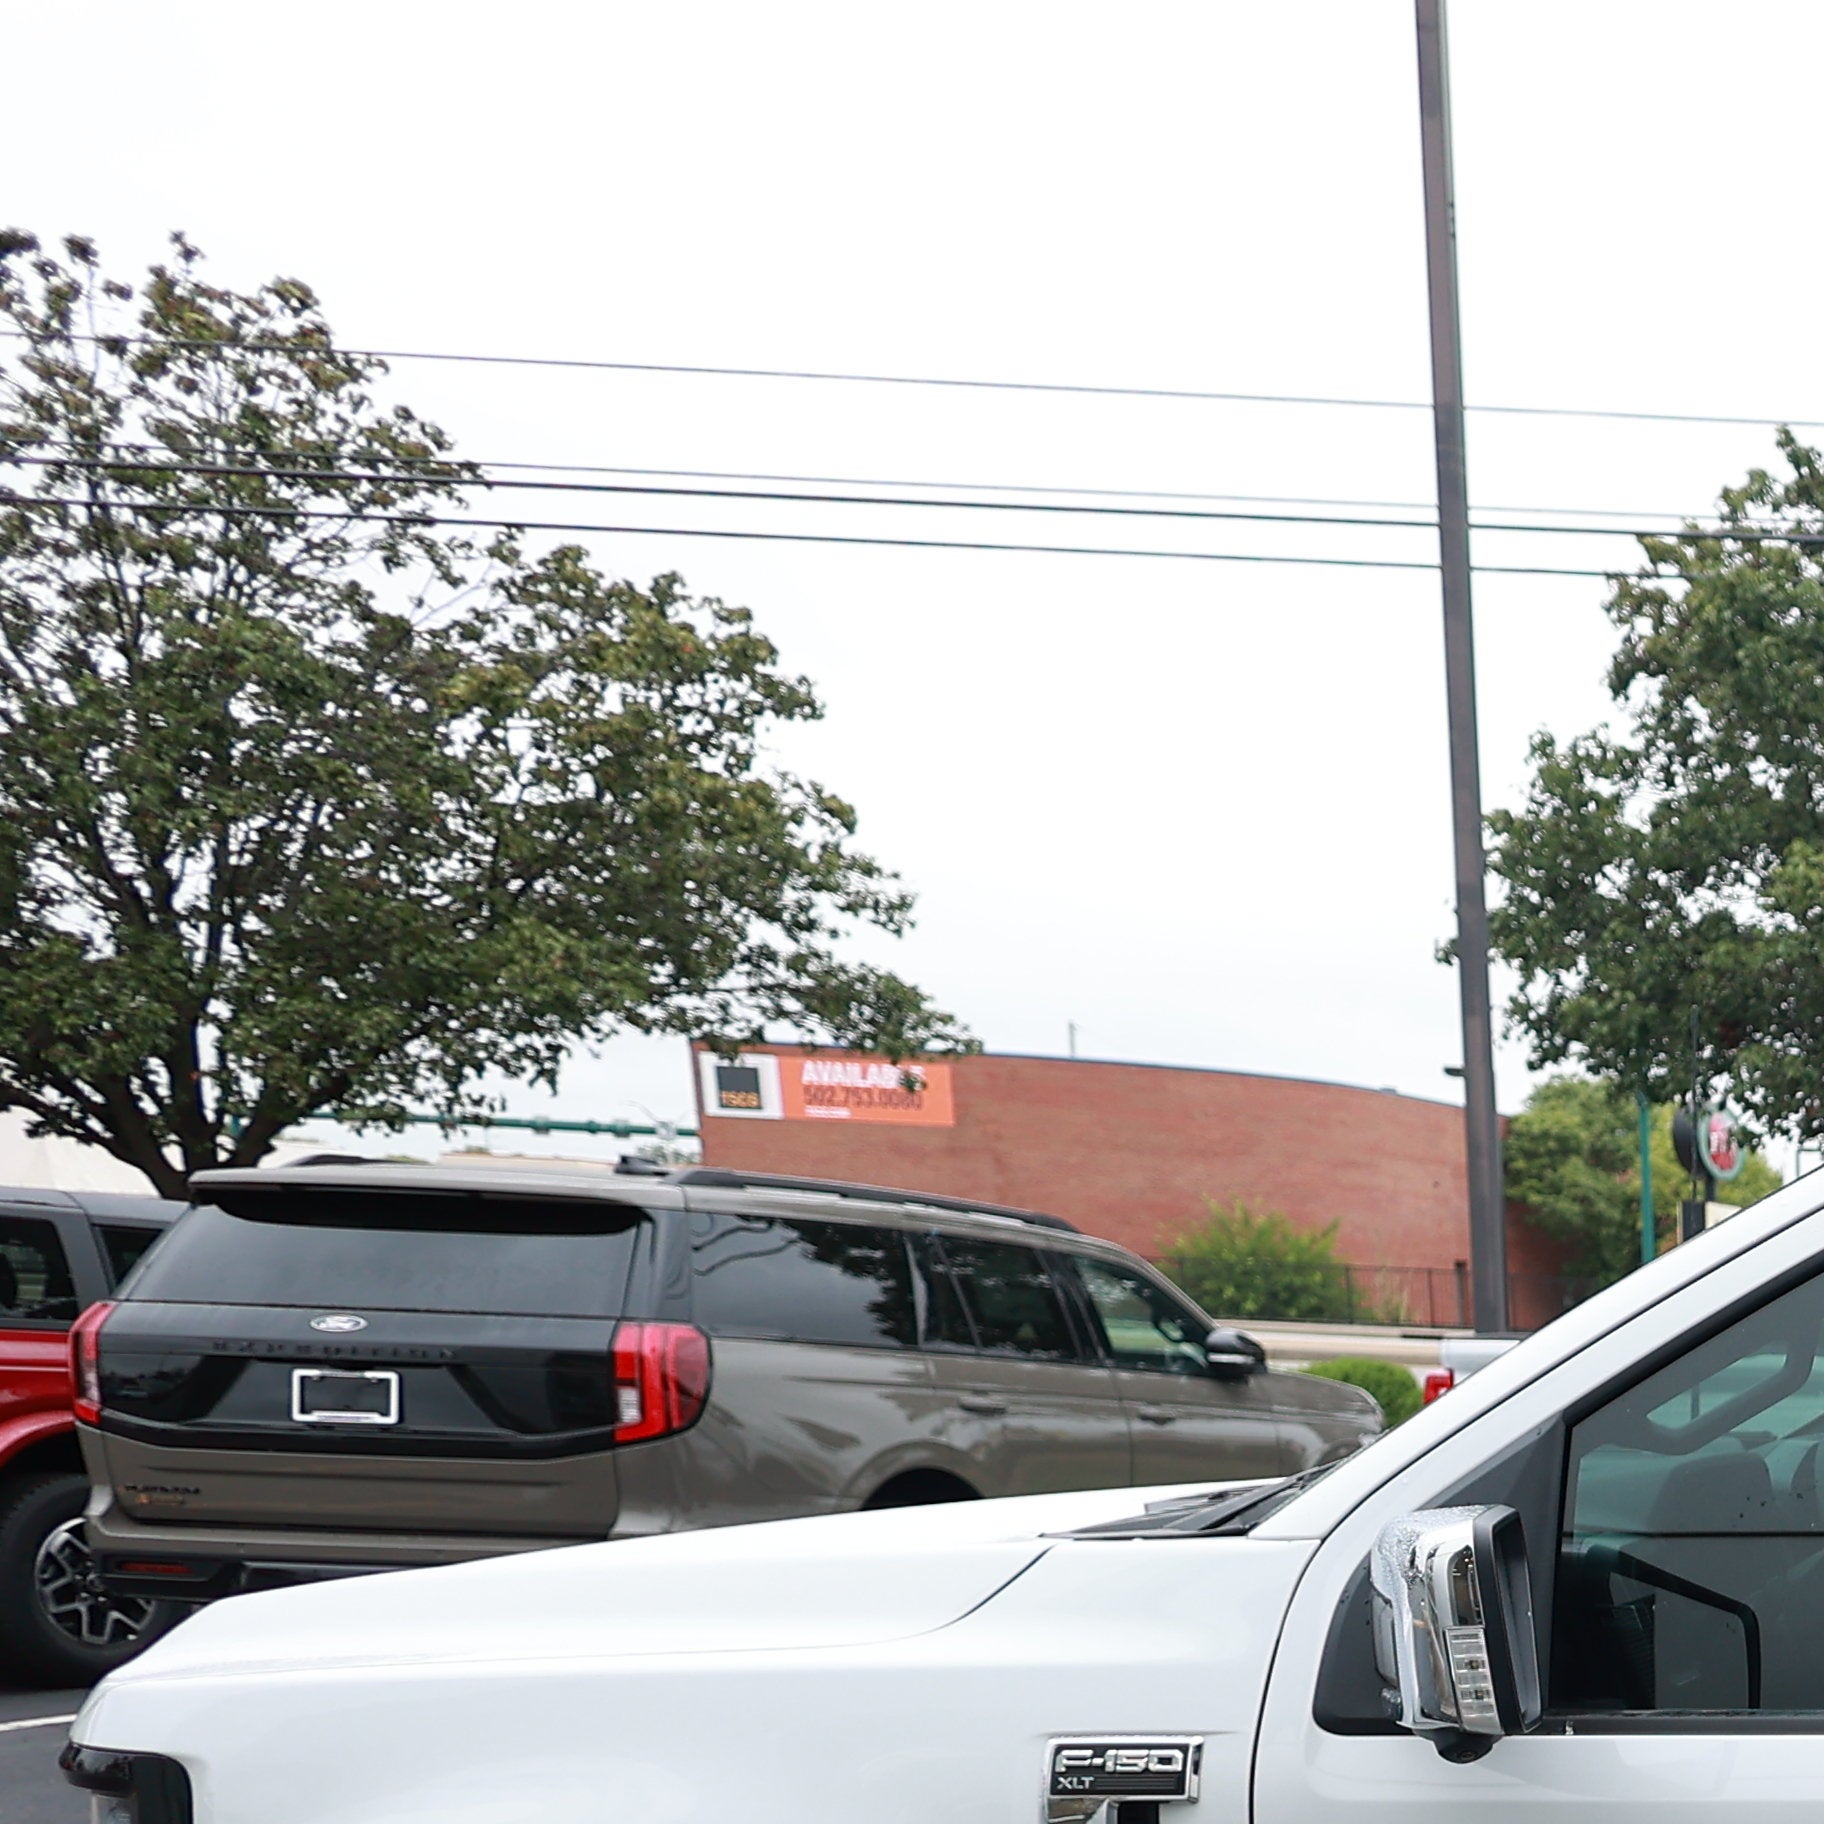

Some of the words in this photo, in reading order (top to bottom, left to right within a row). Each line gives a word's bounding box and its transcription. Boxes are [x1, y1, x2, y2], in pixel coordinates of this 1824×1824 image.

[802, 1060, 926, 1090] AVAILABE
[1055, 1748, 1185, 1774] F-150
[1057, 1776, 1094, 1790] XLT
